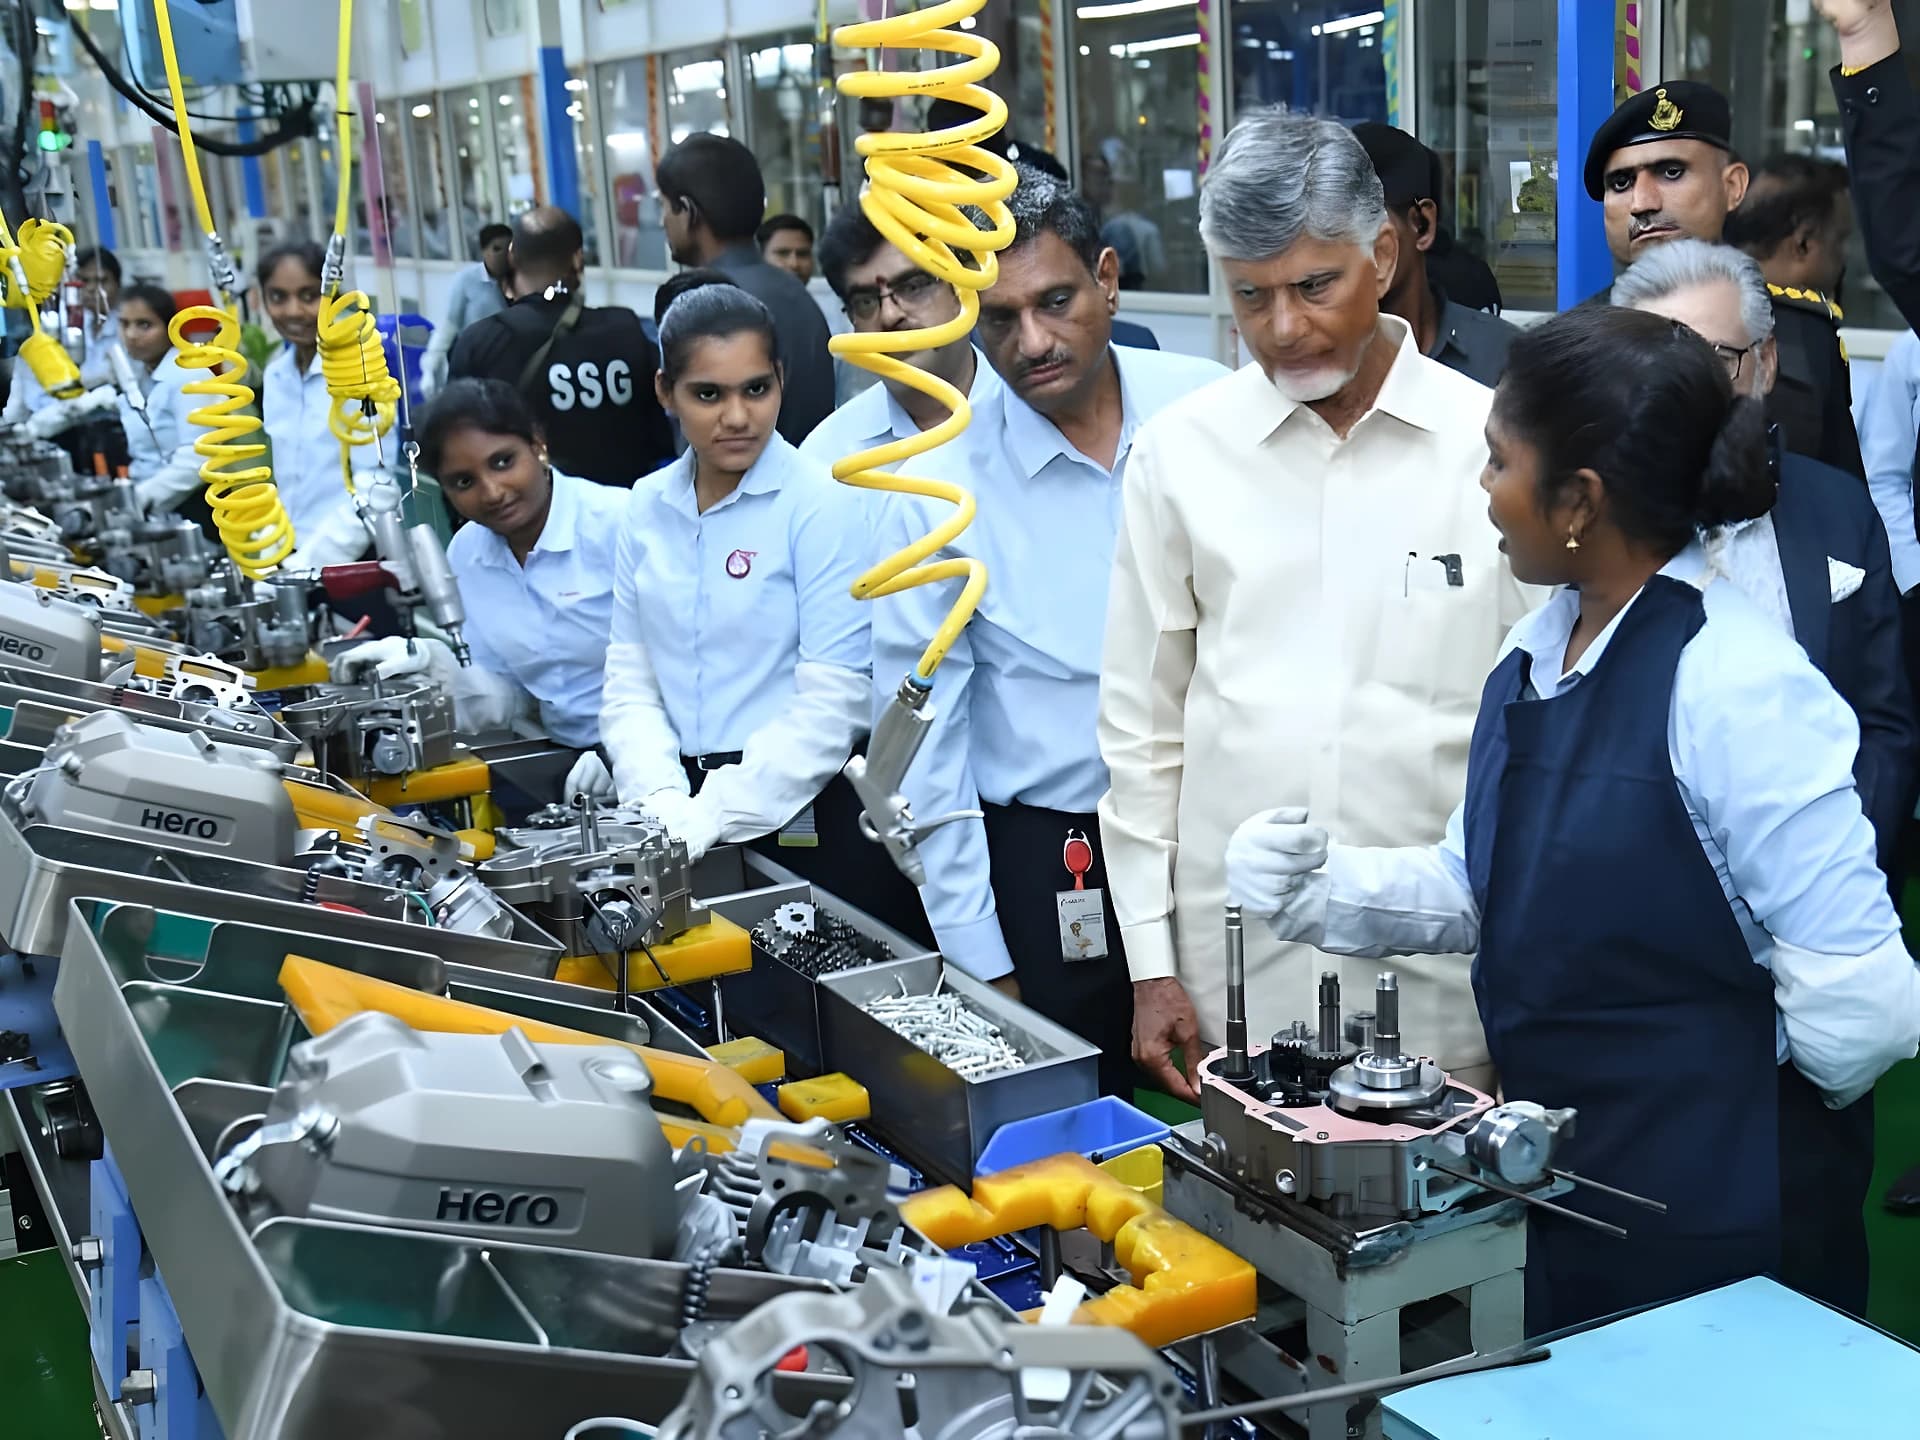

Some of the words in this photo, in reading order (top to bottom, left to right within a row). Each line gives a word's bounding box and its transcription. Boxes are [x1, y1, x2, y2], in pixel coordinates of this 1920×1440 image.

[548, 359, 633, 411] SSG
[140, 808, 218, 839] Hero
[436, 1187, 559, 1226] Hero
